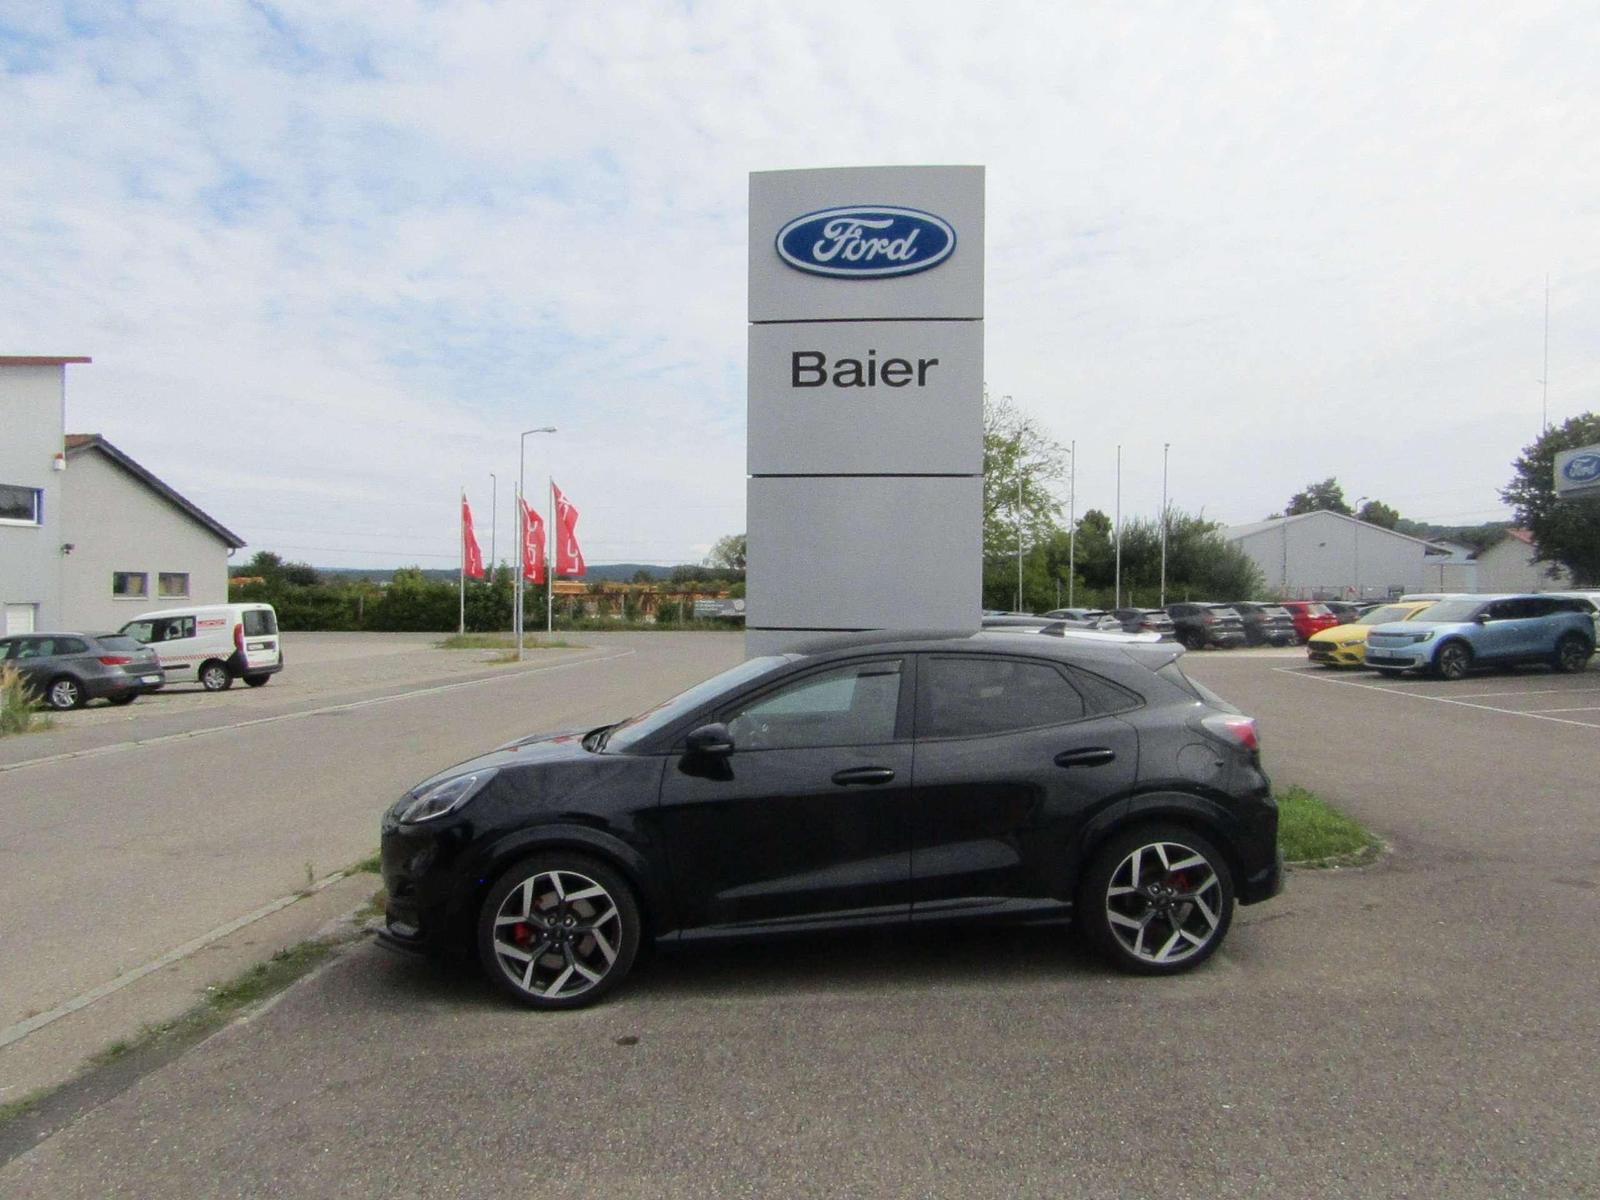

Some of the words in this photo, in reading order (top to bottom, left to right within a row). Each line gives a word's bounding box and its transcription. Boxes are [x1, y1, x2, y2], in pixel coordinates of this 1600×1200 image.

[812, 217, 921, 262] Ford
[791, 349, 940, 388] Baier
[1568, 458, 1599, 478] Ford
